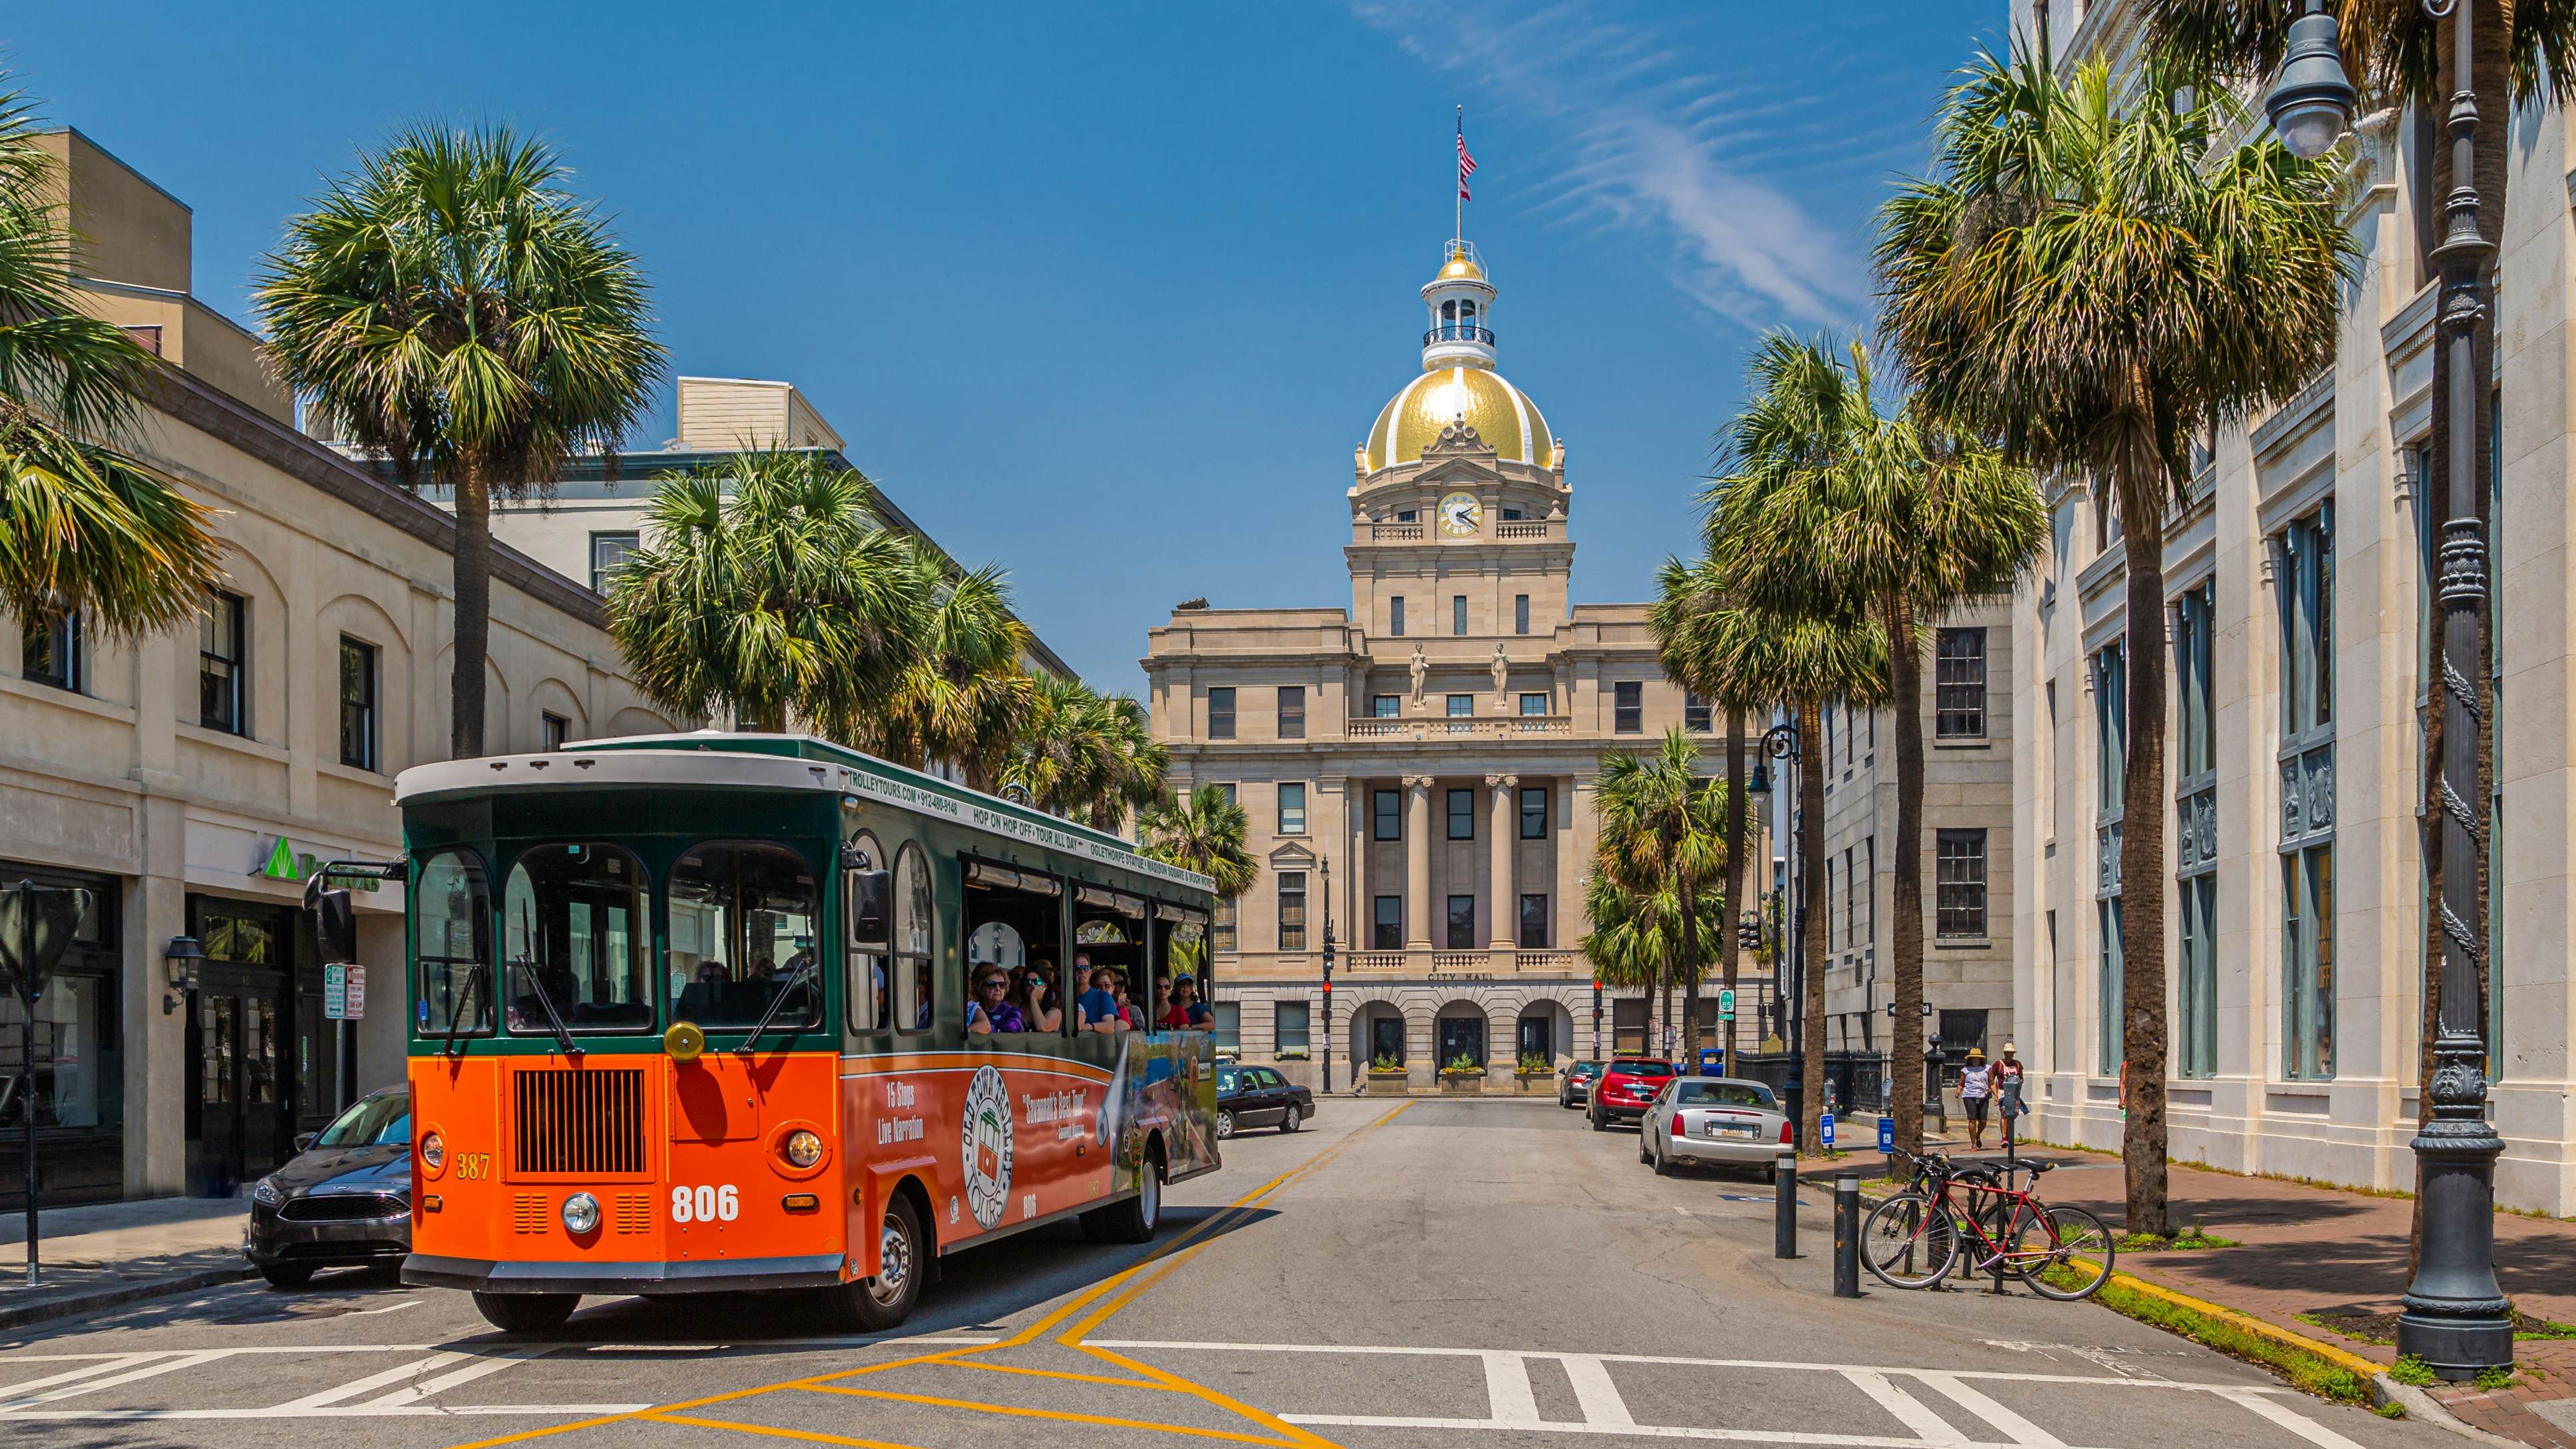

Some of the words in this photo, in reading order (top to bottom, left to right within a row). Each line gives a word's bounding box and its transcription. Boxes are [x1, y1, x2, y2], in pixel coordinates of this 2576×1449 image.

[848, 770, 916, 803] TROLLEYTOURS.COM
[973, 808, 989, 826] HOP
[991, 813, 1001, 830] ON
[1003, 817, 1017, 834] HOP
[1019, 822, 1032, 838] OFF
[1036, 828, 1053, 844] TOUR
[1055, 832, 1065, 848] ALL
[1067, 836, 1077, 851] DAY
[298, 853, 380, 892] RGIONS
[1090, 844, 1125, 864] OGLETHORPE
[1125, 854, 1144, 869] STATUE
[1147, 860, 1167, 875] MADISON
[1167, 866, 1185, 880] SQUARE
[327, 968, 332, 981] 2
[887, 1082, 895, 1108] 15
[897, 1081, 915, 1110] Stops
[1059, 1090, 1071, 1119] Best
[878, 1118, 892, 1144] Live
[893, 1114, 923, 1142] Narration
[963, 1100, 975, 1147] OLD
[971, 1068, 994, 1106] TOWN
[995, 1075, 1013, 1182] TROLLEY
[457, 1152, 490, 1180] 387
[672, 1184, 739, 1222] 806
[967, 1164, 1003, 1227] TOURS
[1023, 1193, 1037, 1219] 806
